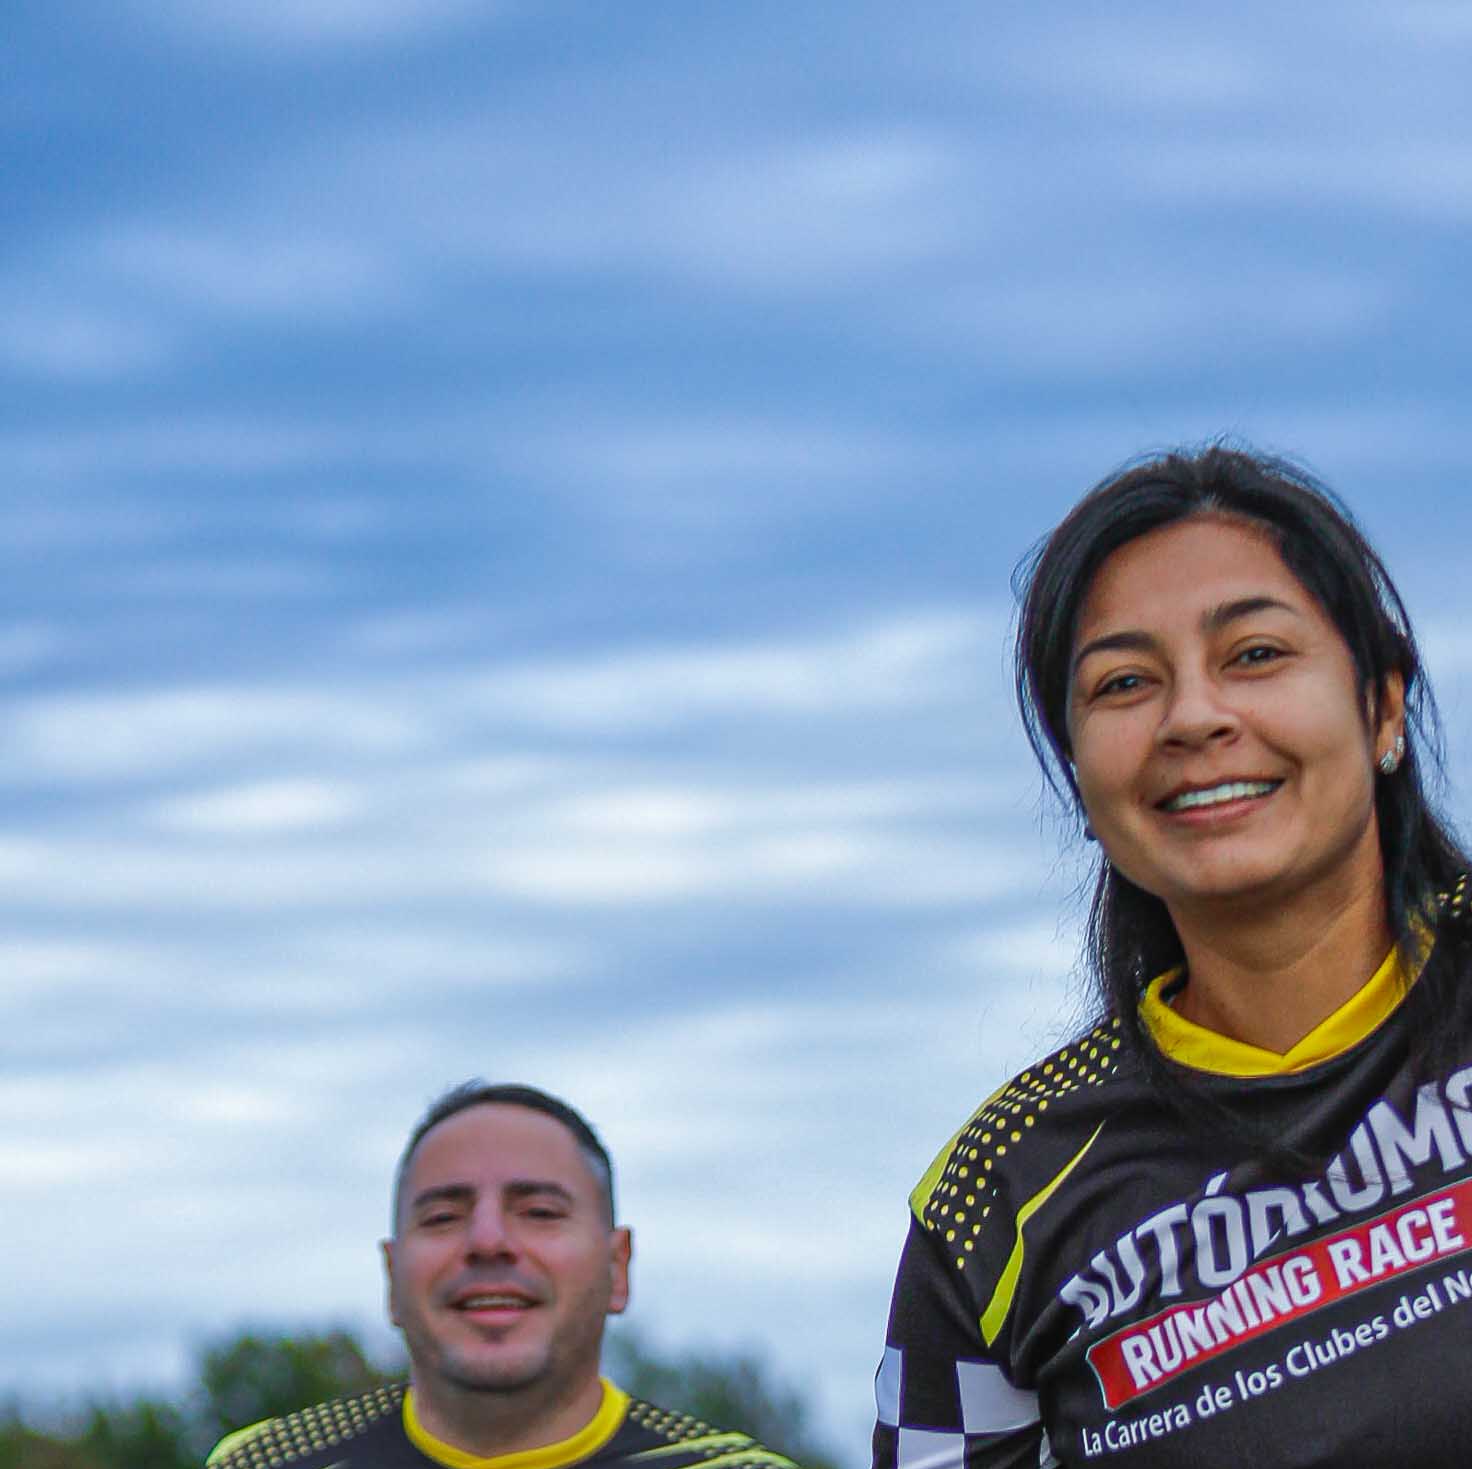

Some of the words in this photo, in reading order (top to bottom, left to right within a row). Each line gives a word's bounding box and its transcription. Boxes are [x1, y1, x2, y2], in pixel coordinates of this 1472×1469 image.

[1083, 1427, 1102, 1457] La
[1104, 1404, 1190, 1451] Carrera
[1196, 1384, 1234, 1417] de
[1239, 1364, 1283, 1401] los
[1286, 1320, 1388, 1377] Clubes
[1393, 1284, 1438, 1327] del
[1122, 1256, 1323, 1390] RUNNING
[1328, 1199, 1465, 1289] RACE
